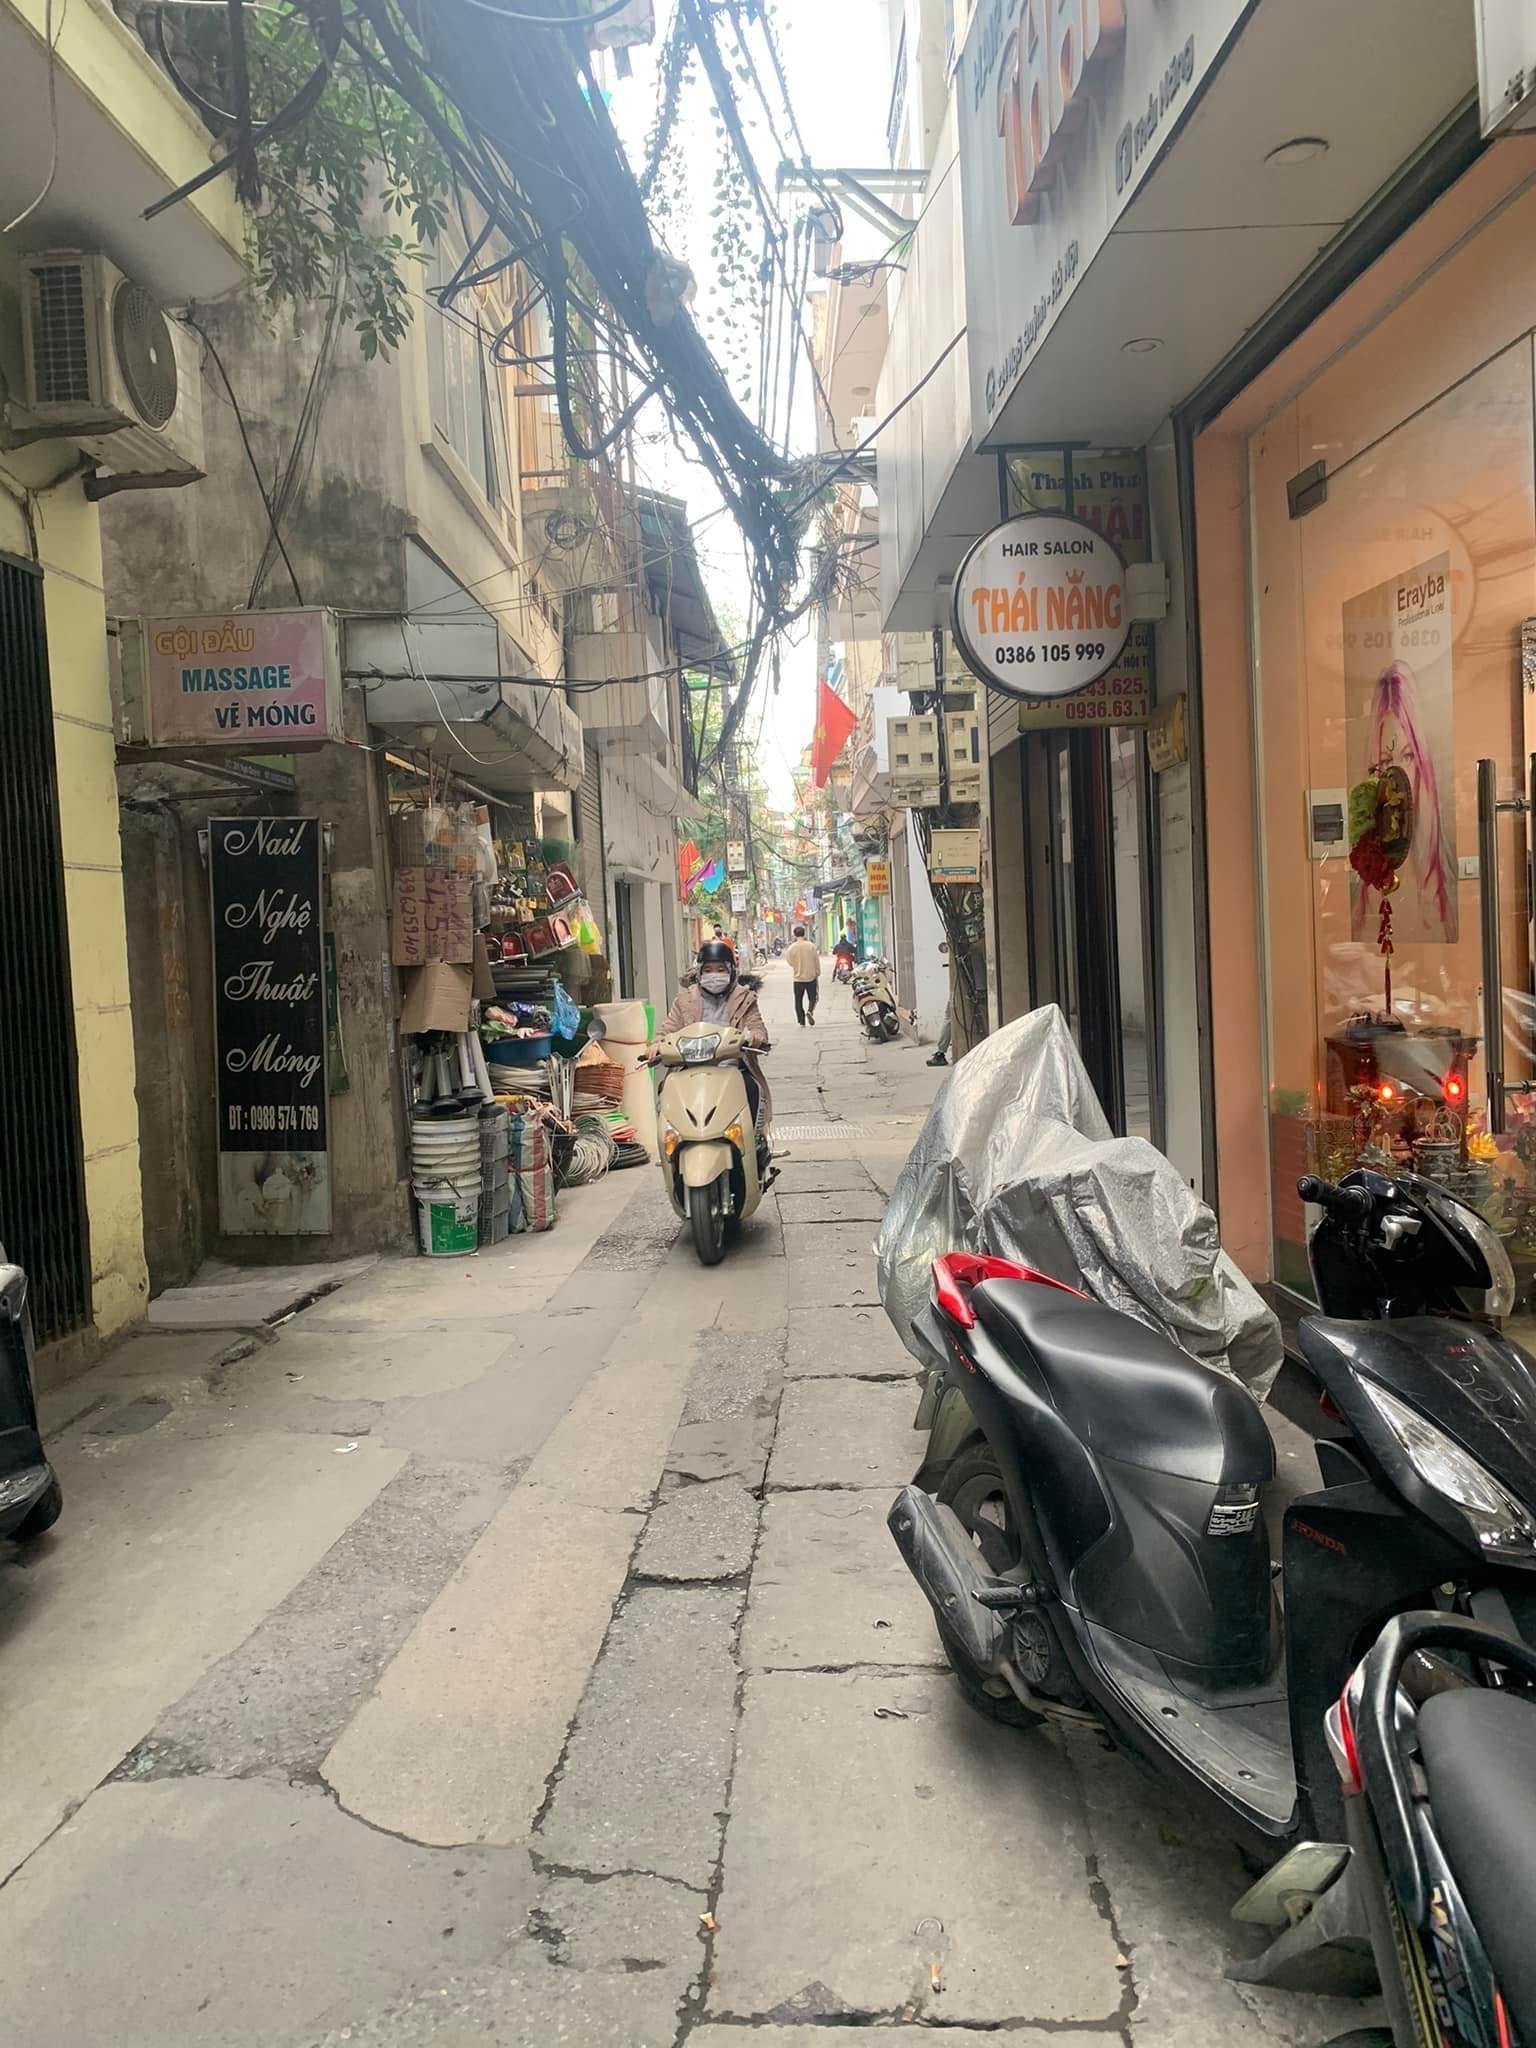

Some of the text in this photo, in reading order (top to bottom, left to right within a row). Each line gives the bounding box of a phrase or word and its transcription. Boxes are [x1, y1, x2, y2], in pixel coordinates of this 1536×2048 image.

[1002, 540, 1094, 557] HAIR SALON
[971, 571, 1038, 635] THÁI
[1397, 575, 1445, 612] Erayba
[155, 620, 255, 661] GỘI ĐẦU
[995, 643, 1105, 664] 0386 105 999
[181, 664, 292, 693] MASSAGE
[215, 701, 316, 729] VẼ MÓNG
[224, 819, 307, 856] Nail
[224, 888, 312, 945] Nghệ
[224, 960, 319, 1009] Thuật
[226, 1033, 321, 1089] Móng
[250, 1104, 276, 1131] 0988
[278, 1104, 298, 1131] 574
[299, 1104, 319, 1131] 769
